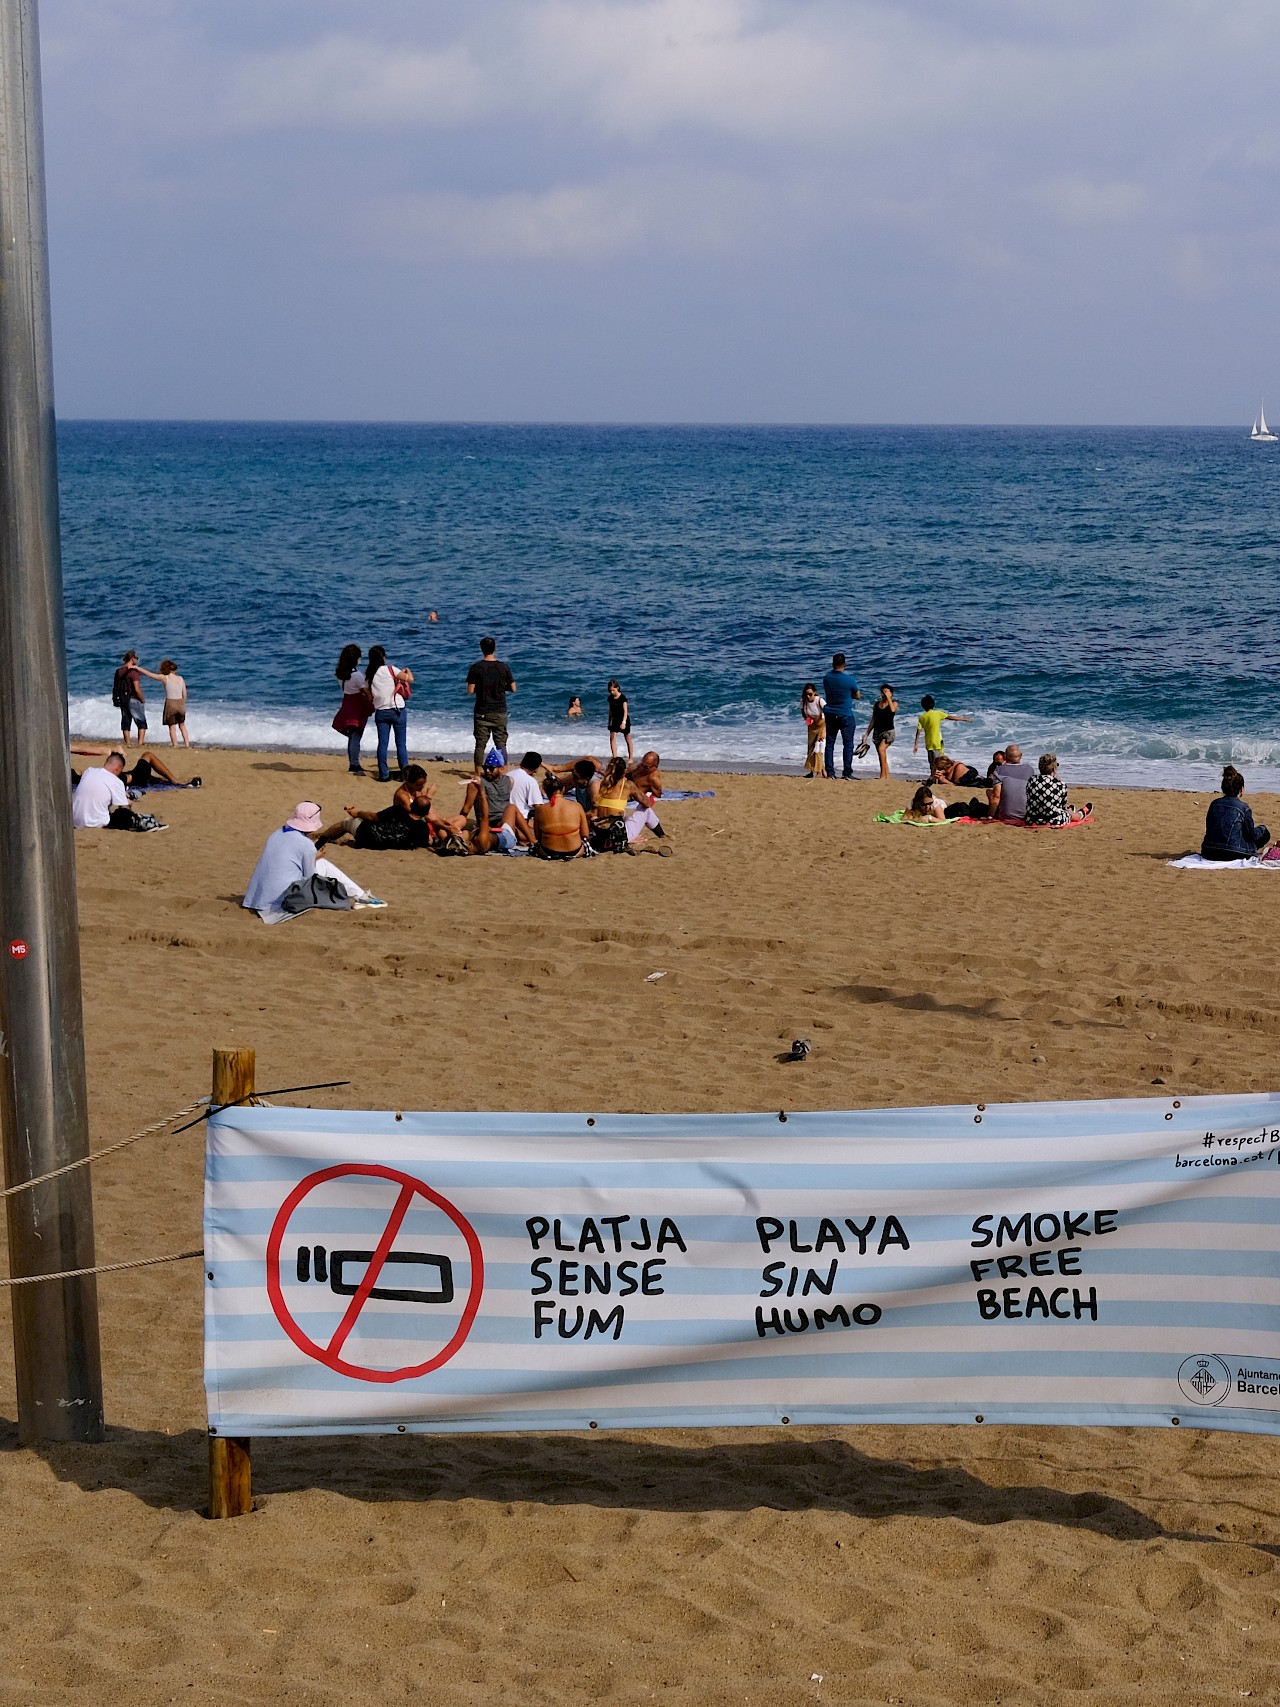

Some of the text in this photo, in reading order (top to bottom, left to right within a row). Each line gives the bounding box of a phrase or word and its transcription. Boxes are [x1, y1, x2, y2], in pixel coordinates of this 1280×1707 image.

[526, 1215, 687, 1253] PLATJA
[756, 1215, 910, 1255] PLAYA
[971, 1210, 1119, 1249] SMOKE
[531, 1257, 666, 1296] SENSE
[760, 1259, 839, 1297] SIN
[971, 1247, 1083, 1282] FREE
[535, 1300, 625, 1340] FUM
[756, 1303, 882, 1337] HUMO
[977, 1287, 1098, 1322] BEACH
